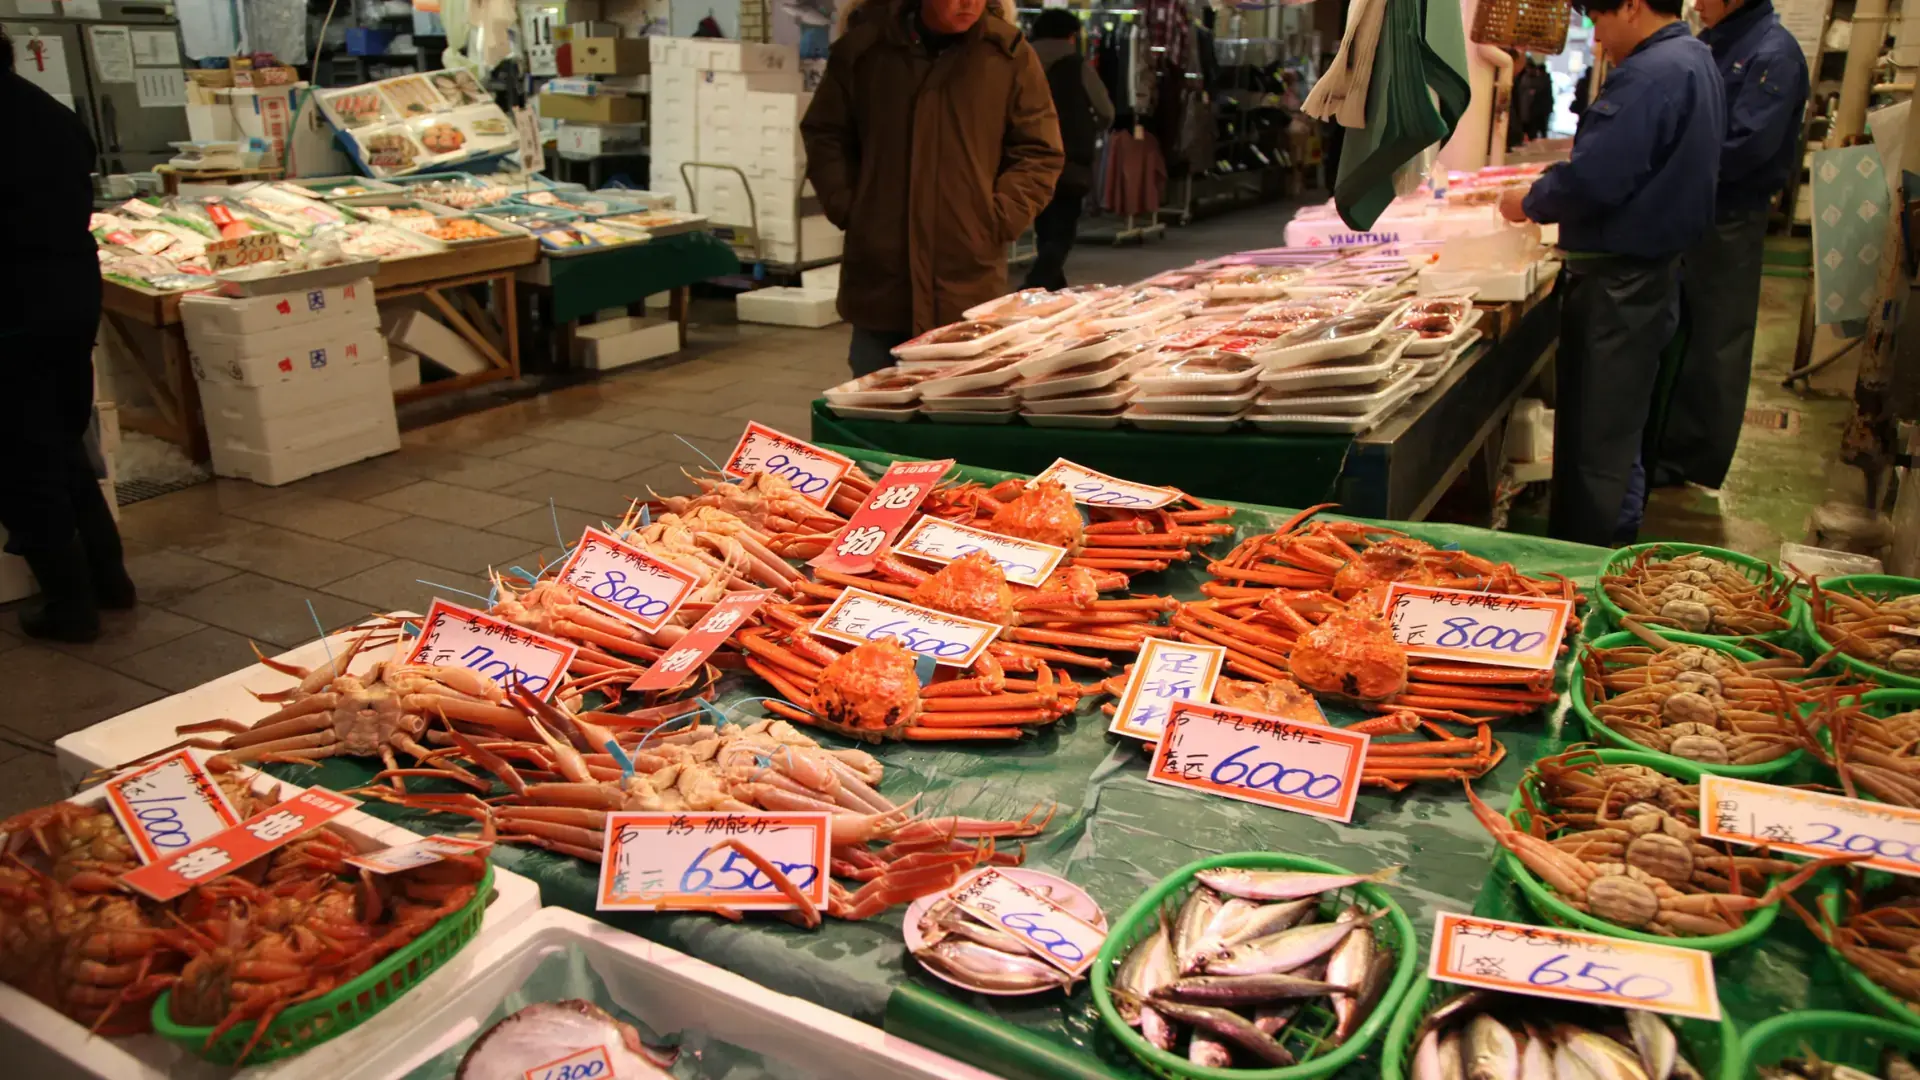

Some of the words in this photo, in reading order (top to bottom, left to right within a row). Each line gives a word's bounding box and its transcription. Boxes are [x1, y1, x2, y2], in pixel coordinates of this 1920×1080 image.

[836, 484, 921, 556] 地物
[1001, 912, 1085, 962] 600
[1526, 953, 1674, 1001] 650
